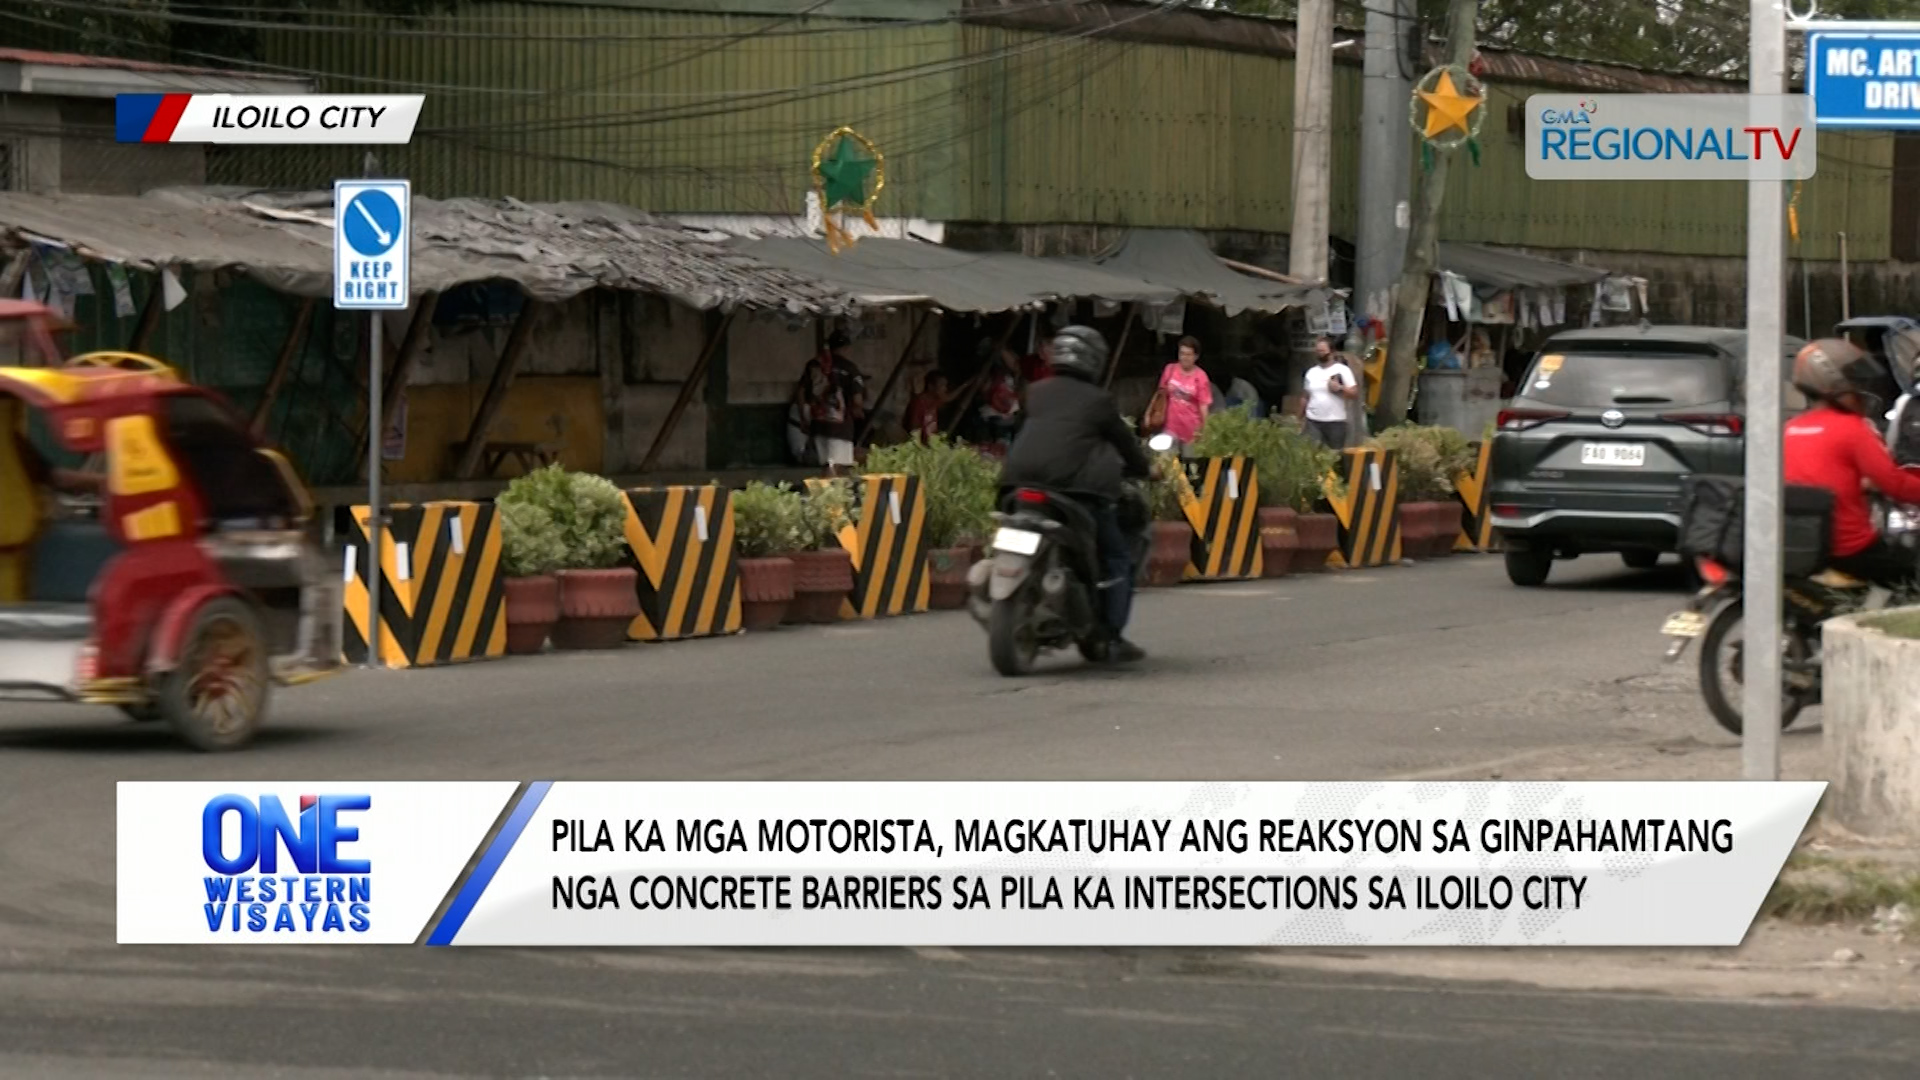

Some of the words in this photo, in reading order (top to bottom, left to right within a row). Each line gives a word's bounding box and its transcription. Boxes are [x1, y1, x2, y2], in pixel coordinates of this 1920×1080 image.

[1826, 47, 1874, 77] MC.
[350, 261, 393, 279] KEEP
[344, 281, 398, 300] RIGHT
